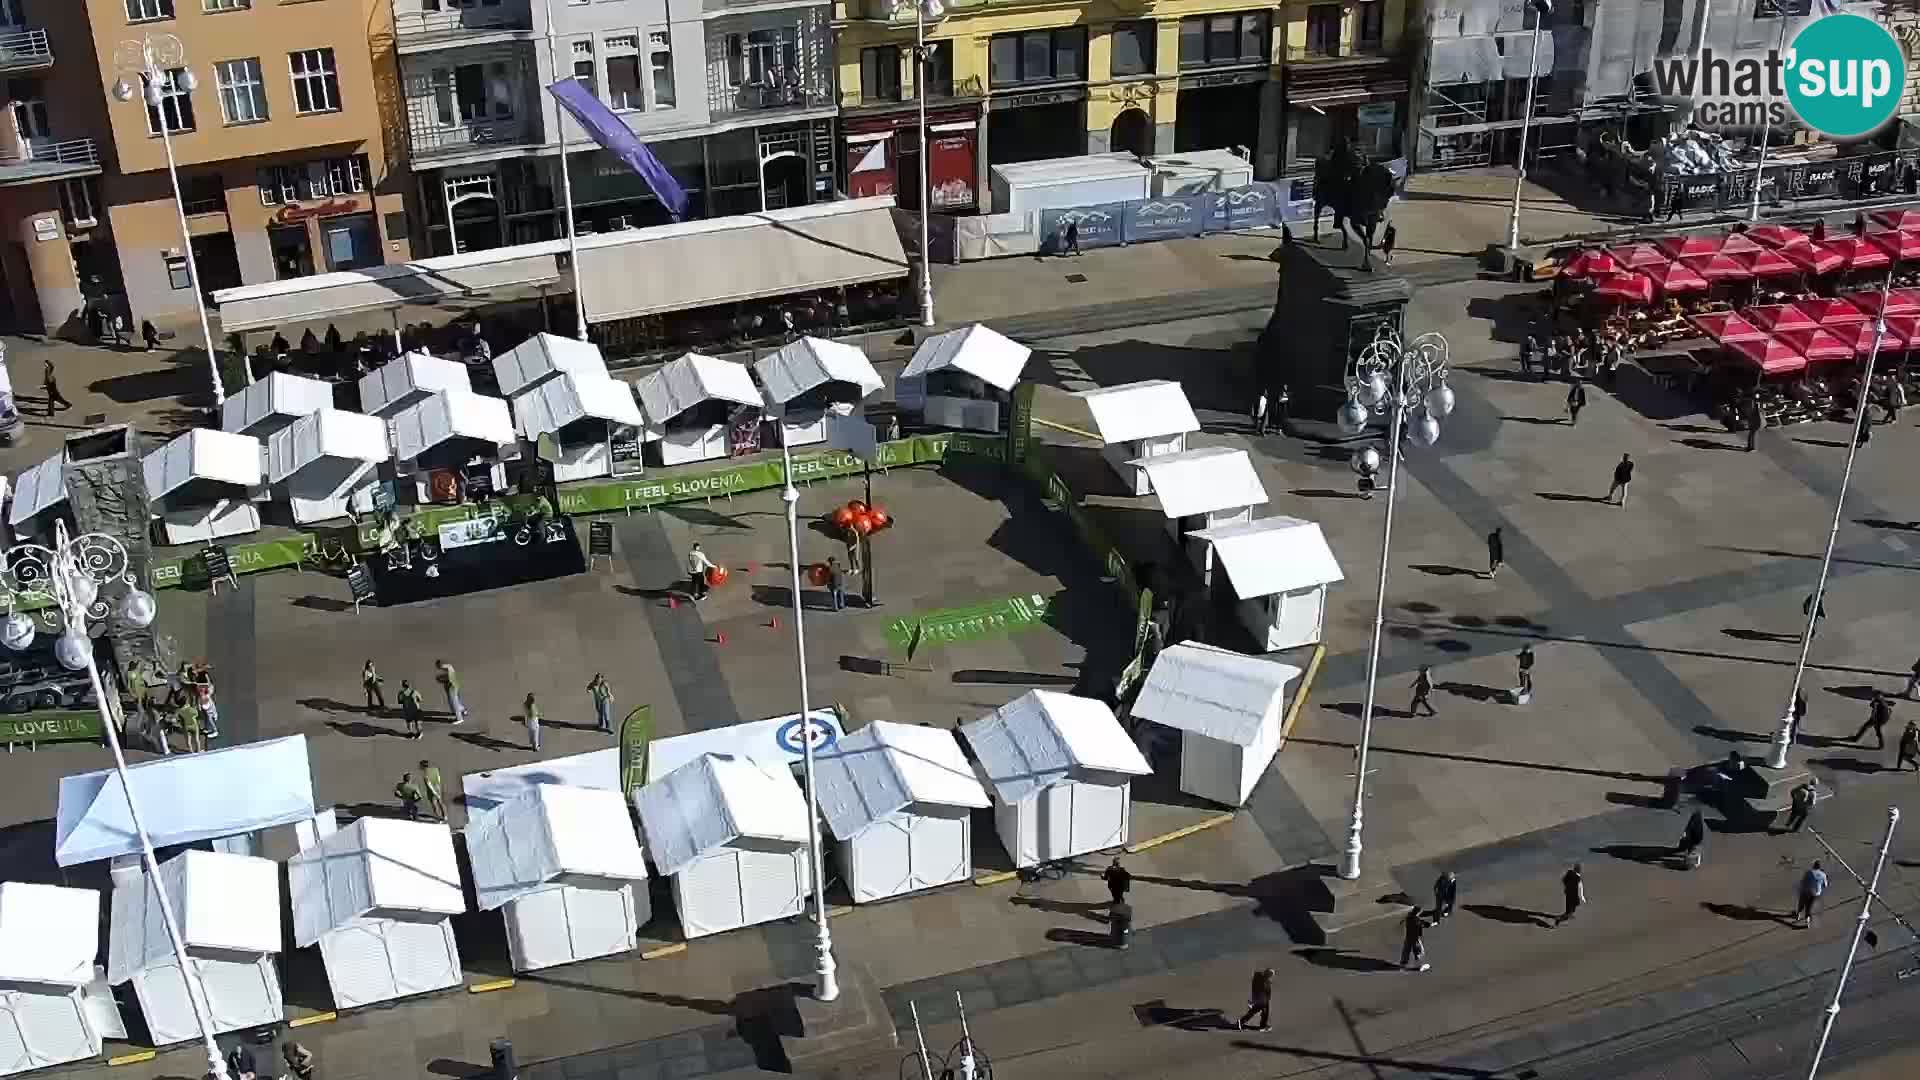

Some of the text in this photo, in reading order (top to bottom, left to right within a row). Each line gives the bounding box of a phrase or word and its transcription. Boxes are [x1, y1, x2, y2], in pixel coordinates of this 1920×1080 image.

[625, 473, 745, 501] I FEEL SLOVENIA
